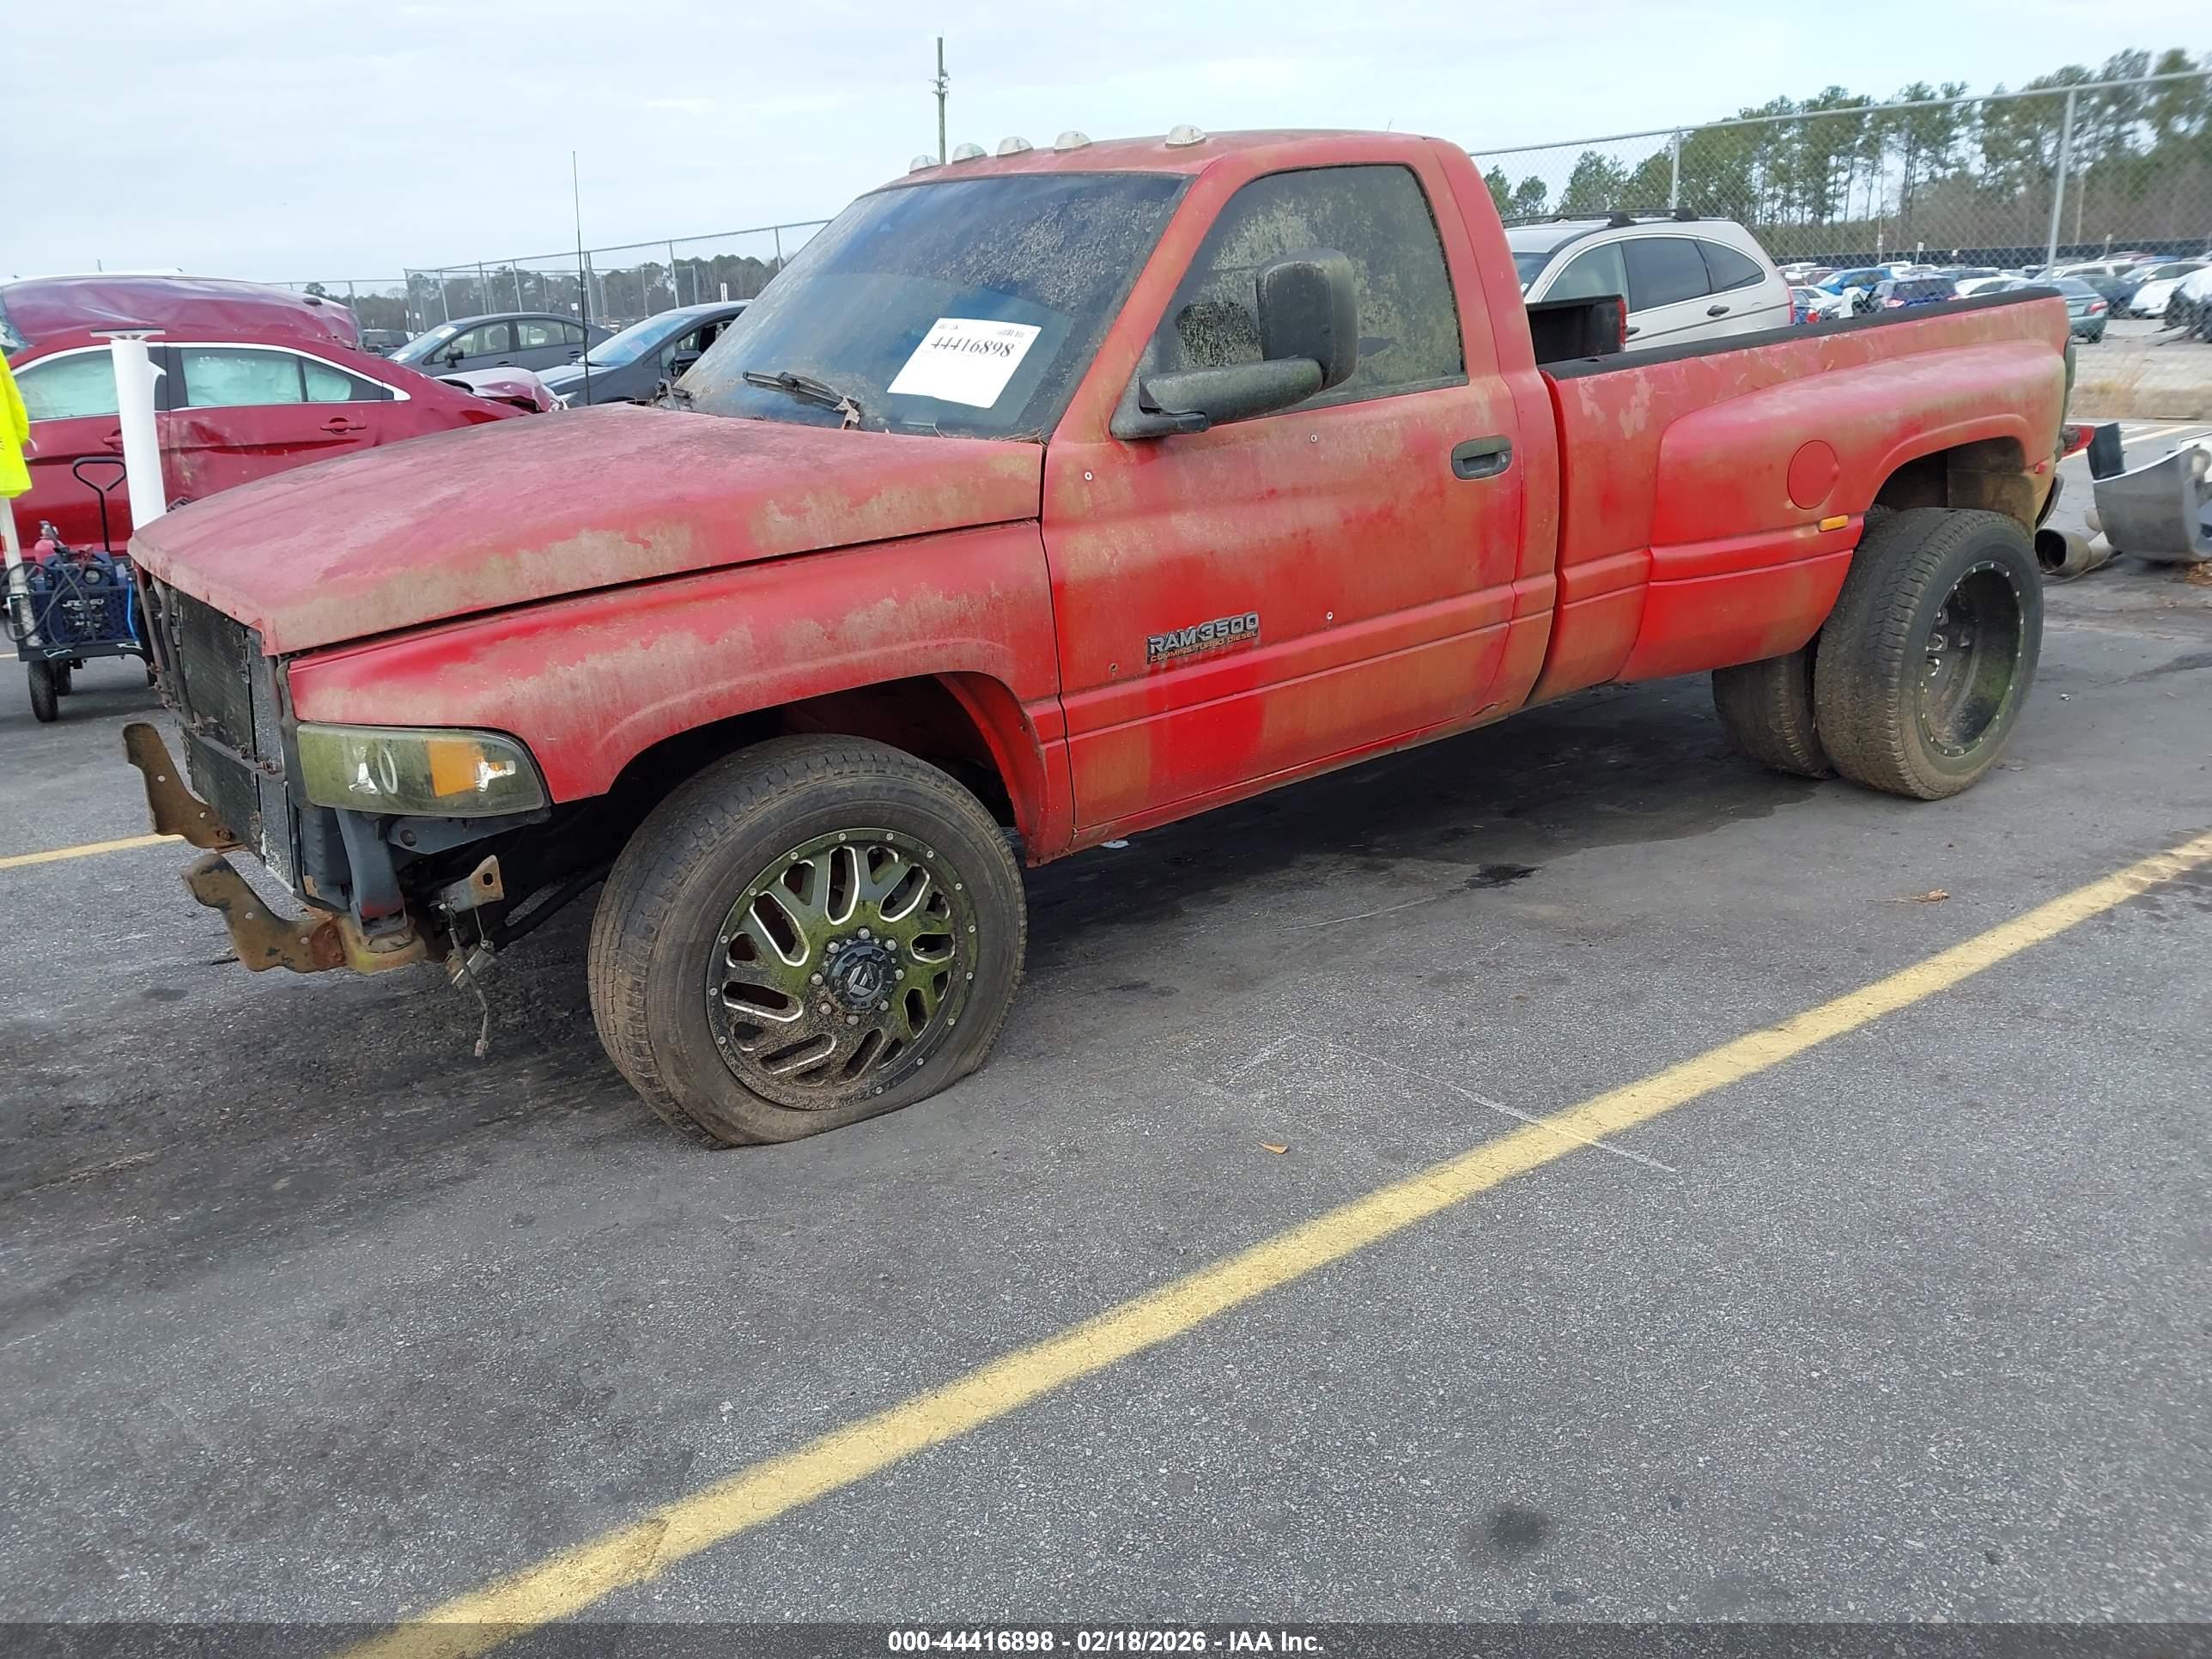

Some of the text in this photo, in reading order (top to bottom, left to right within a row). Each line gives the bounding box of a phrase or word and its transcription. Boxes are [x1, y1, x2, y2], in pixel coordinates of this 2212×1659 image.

[931, 337, 1015, 357] 44416898
[1150, 632, 1258, 662] CUMMINS TURBO DIESEL
